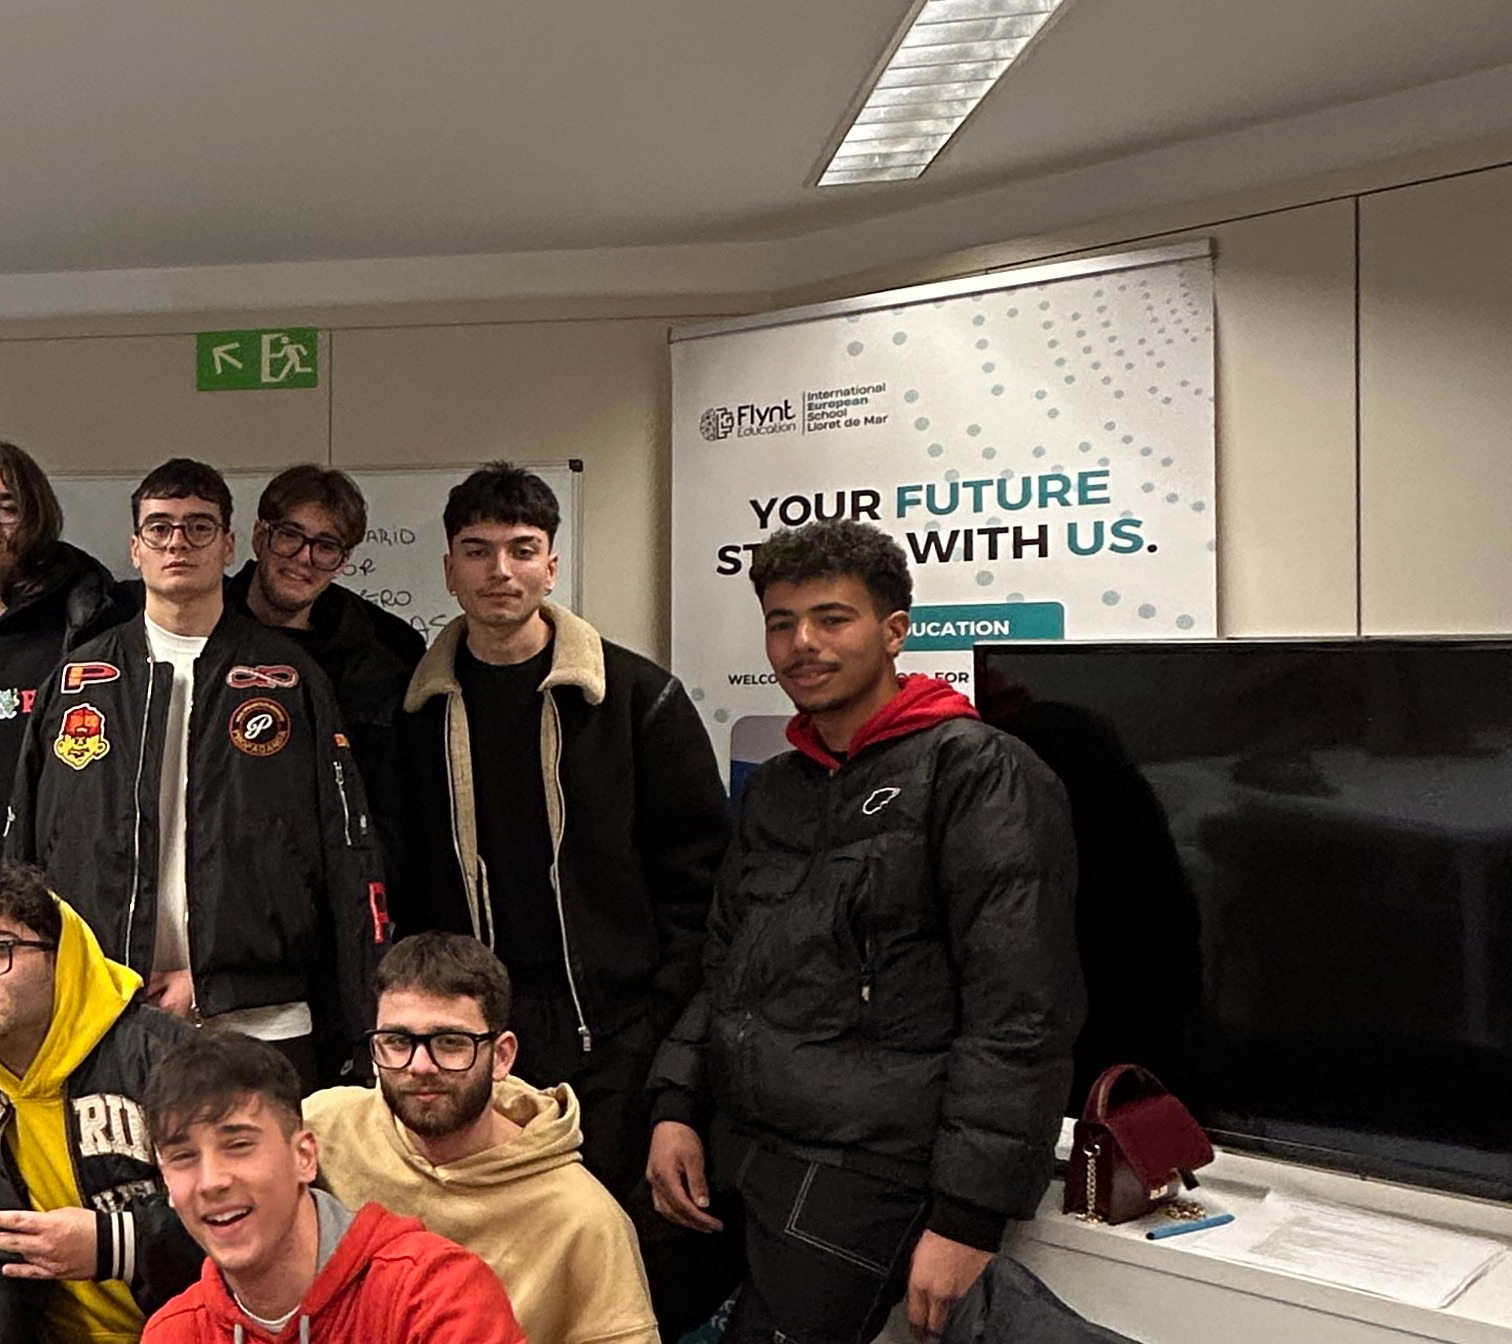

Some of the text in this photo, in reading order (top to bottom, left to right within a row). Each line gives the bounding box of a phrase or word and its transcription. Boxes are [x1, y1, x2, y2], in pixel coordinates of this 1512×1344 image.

[807, 382, 886, 401] International
[737, 399, 796, 426] Flynt
[807, 397, 869, 411] European
[807, 408, 848, 422] School
[844, 417, 861, 428] de
[864, 415, 889, 426] Mar
[737, 423, 797, 438] Education
[749, 469, 1111, 529] YOUR FUTURE
[906, 523, 1049, 565] WITH
[1067, 517, 1159, 557] US.
[906, 620, 1010, 637] UCATION
